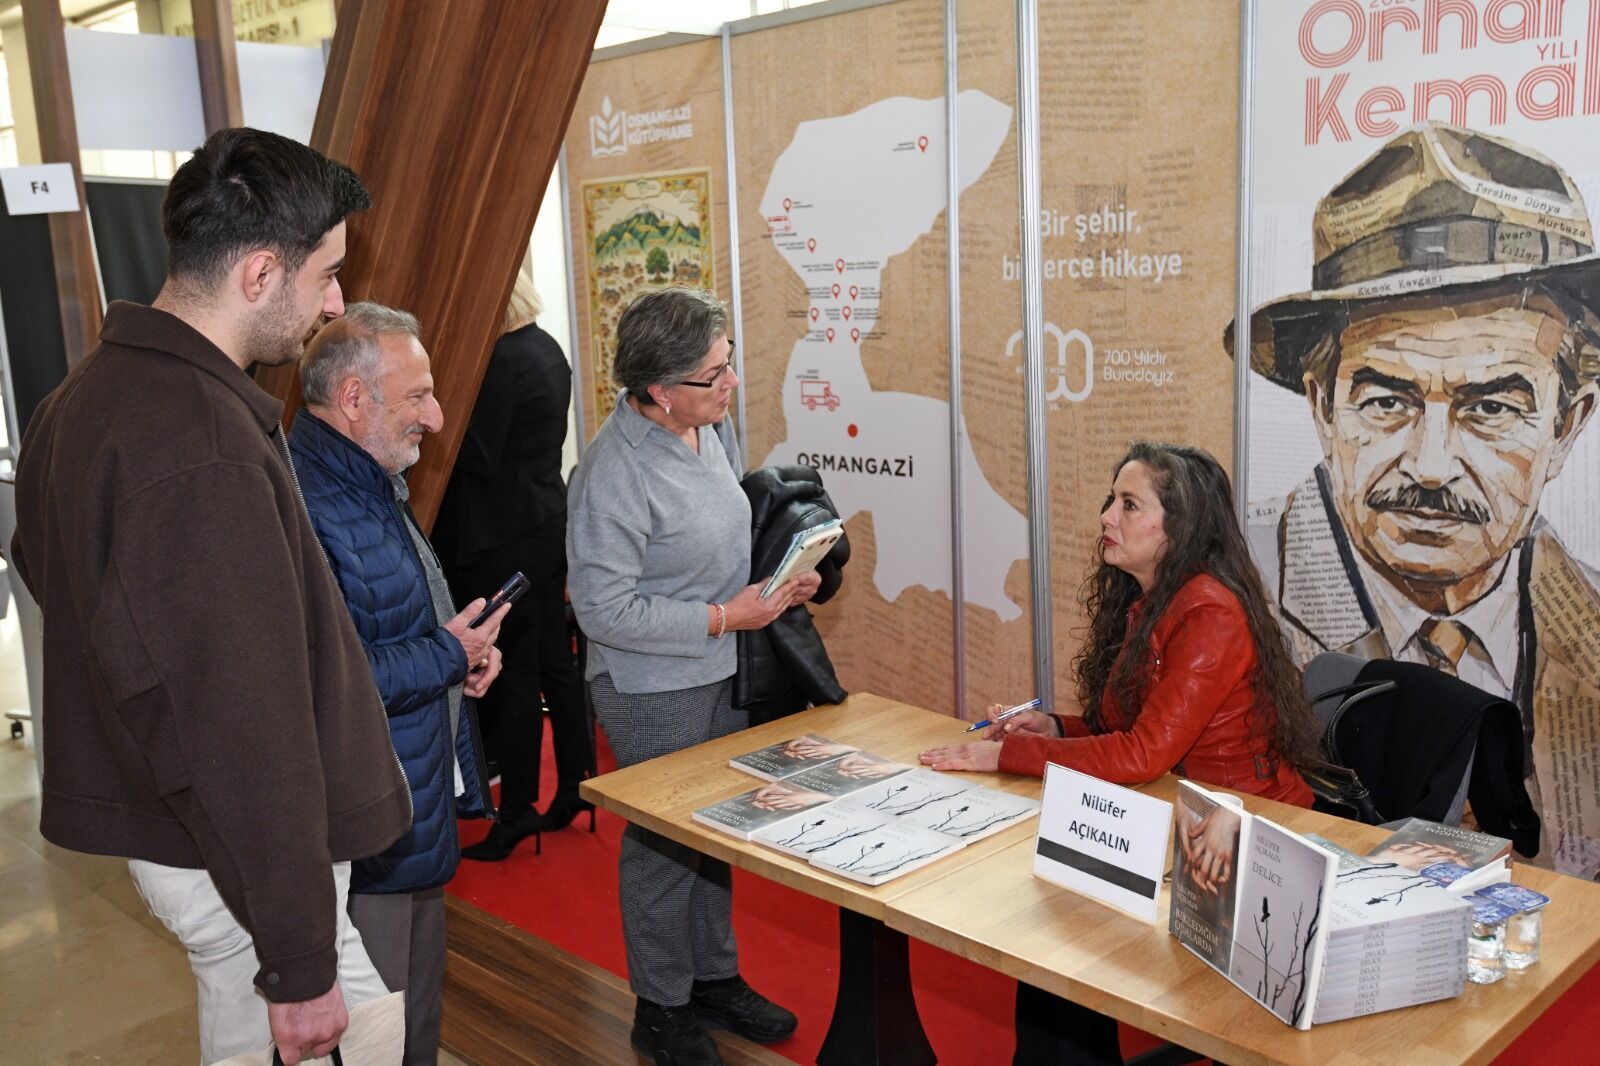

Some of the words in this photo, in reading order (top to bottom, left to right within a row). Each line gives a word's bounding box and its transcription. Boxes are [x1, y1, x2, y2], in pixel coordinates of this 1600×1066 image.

[1536, 39, 1577, 61] YILI
[1304, 60, 1600, 146] Kemal
[31, 181, 49, 195] F4
[1524, 196, 1561, 214] Dünya
[1040, 209, 1070, 237] Bir
[1074, 203, 1142, 242] şehir,
[1537, 213, 1586, 238] Murtaza
[1003, 254, 1094, 281] bierce
[1100, 248, 1183, 283] hikaye
[1103, 349, 1130, 366] 700
[1103, 367, 1174, 387] Buradayız
[797, 452, 914, 478] OSMANGAZİ
[1081, 792, 1126, 819] Nilüfer
[1068, 820, 1130, 853] AÇIKALIN
[1252, 861, 1283, 888] DELİCE
